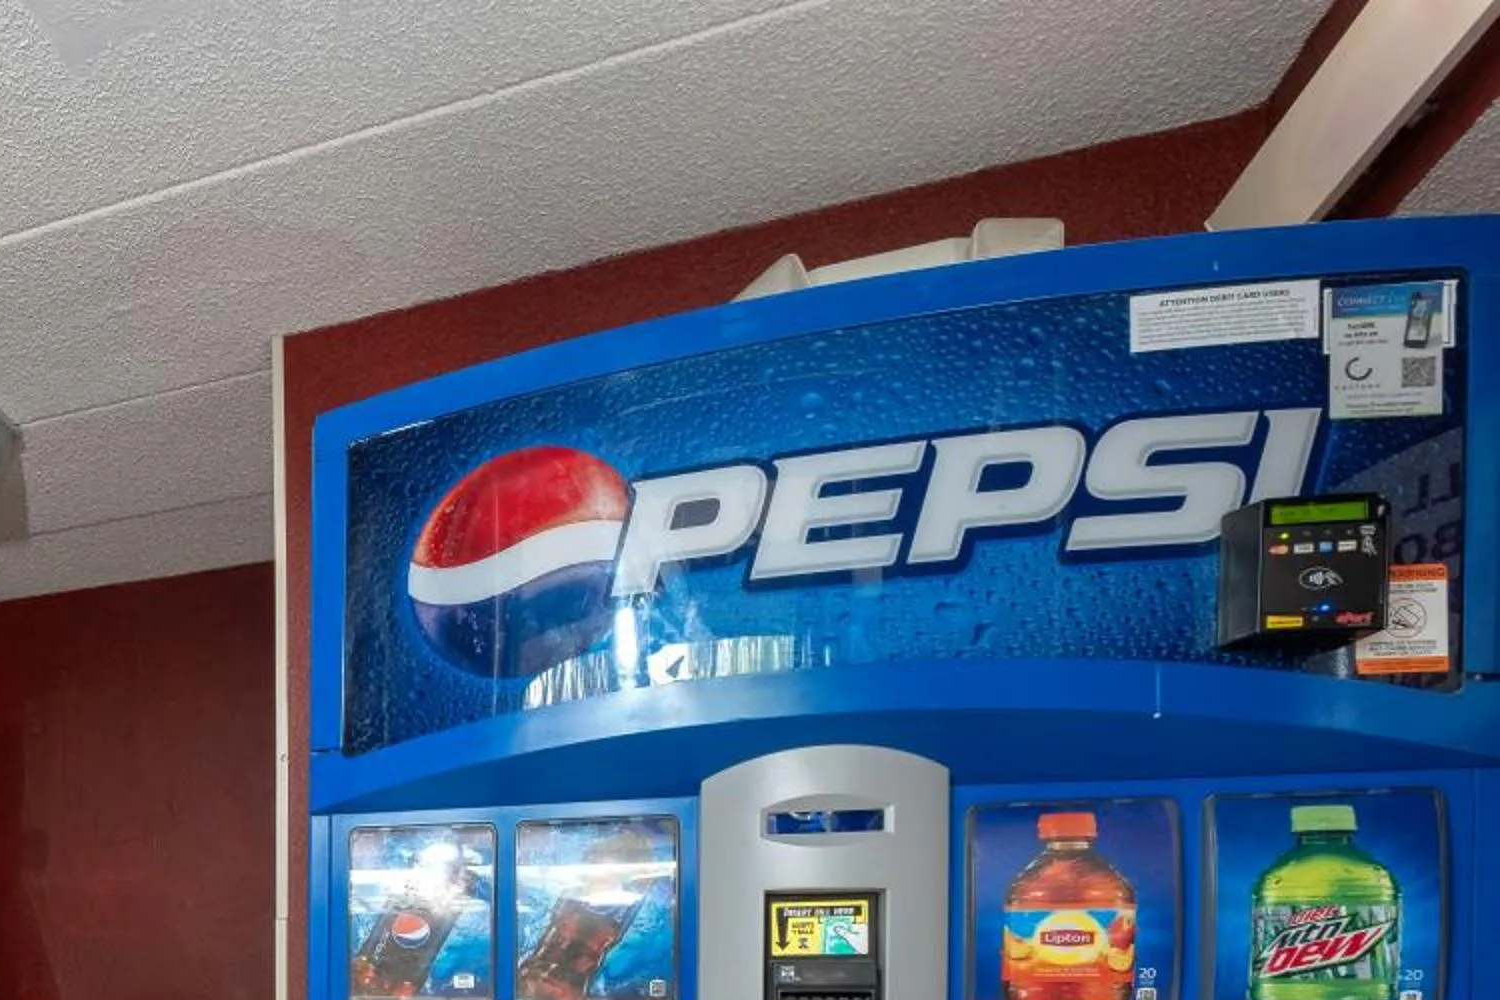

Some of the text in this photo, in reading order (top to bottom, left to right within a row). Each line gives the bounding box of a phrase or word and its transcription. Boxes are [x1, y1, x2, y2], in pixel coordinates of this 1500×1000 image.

[610, 408, 1322, 600] PEPSI
[1043, 931, 1092, 945] Lipton
[1138, 966, 1157, 980] 20
[1403, 968, 1424, 982] 20
